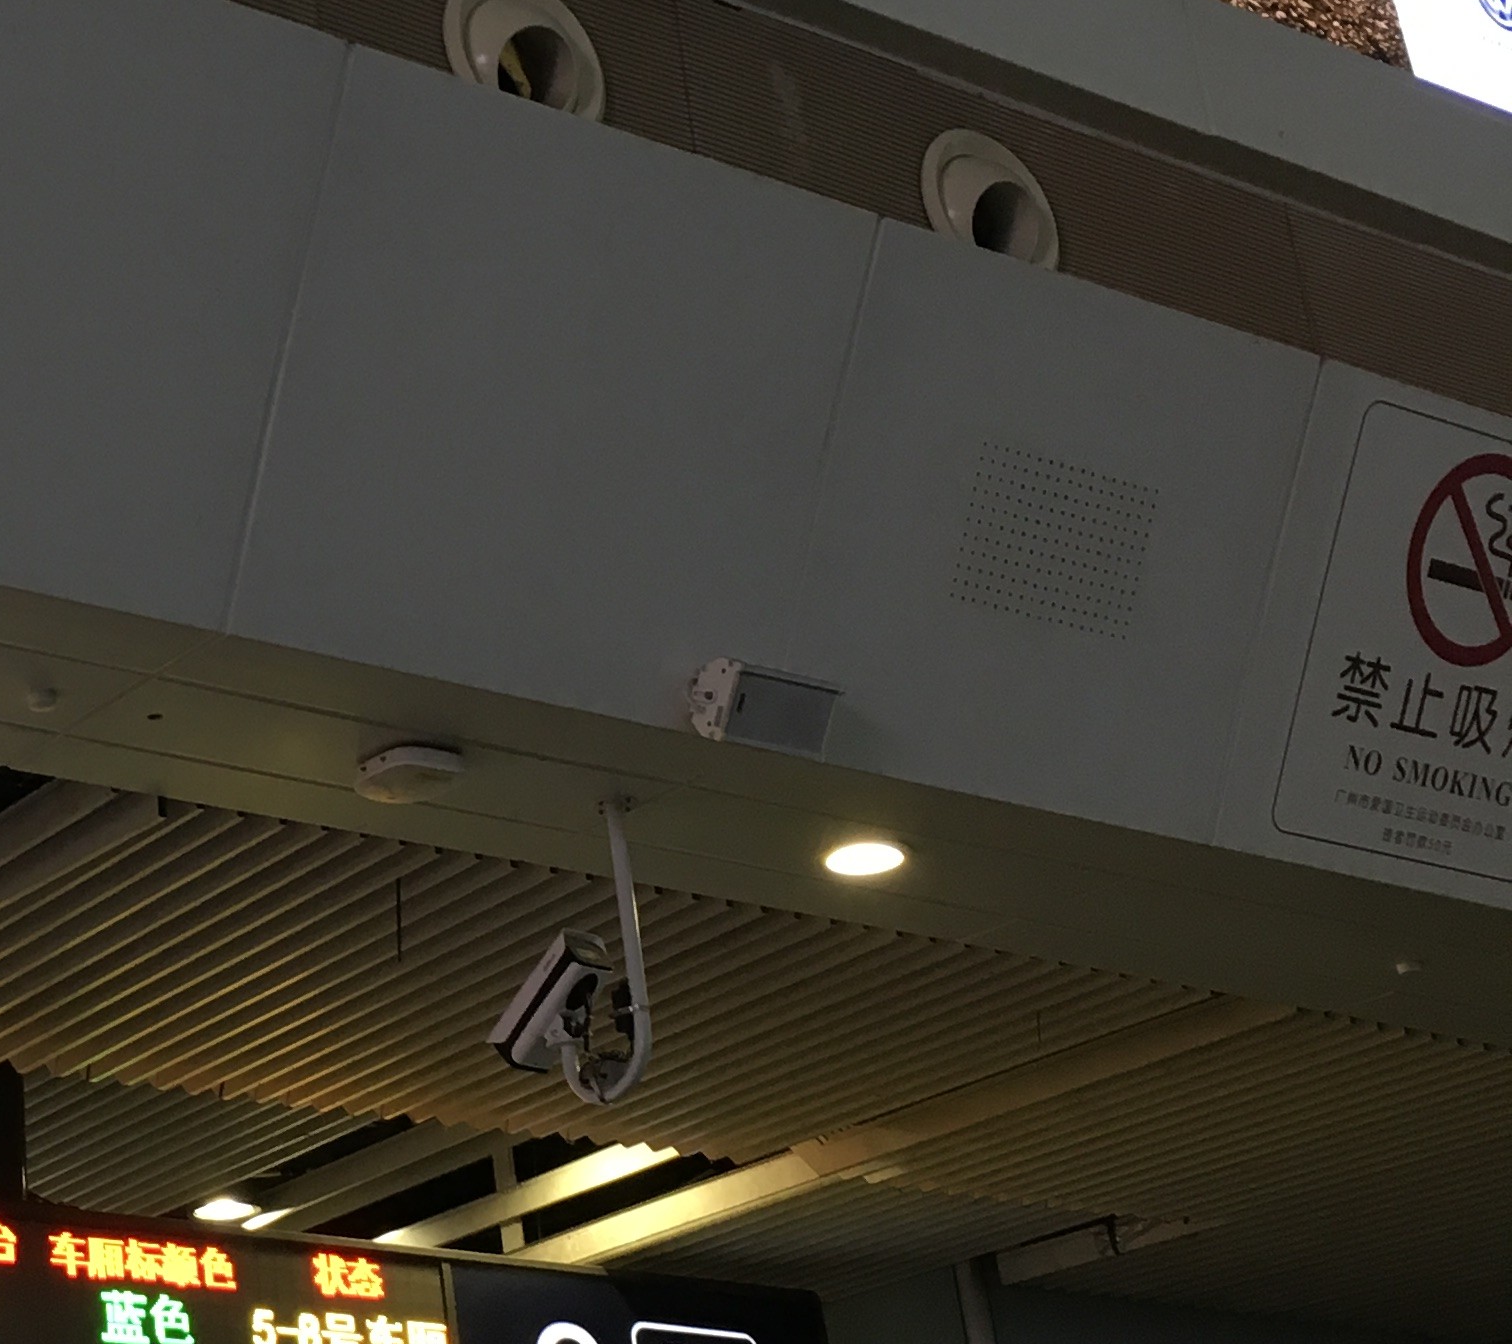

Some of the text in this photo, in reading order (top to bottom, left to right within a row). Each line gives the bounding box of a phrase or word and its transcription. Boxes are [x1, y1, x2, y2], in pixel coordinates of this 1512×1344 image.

[1331, 651, 1512, 757] 禁止吸
[1344, 745, 1511, 807] NO SMOKING
[311, 1252, 386, 1299] 状态
